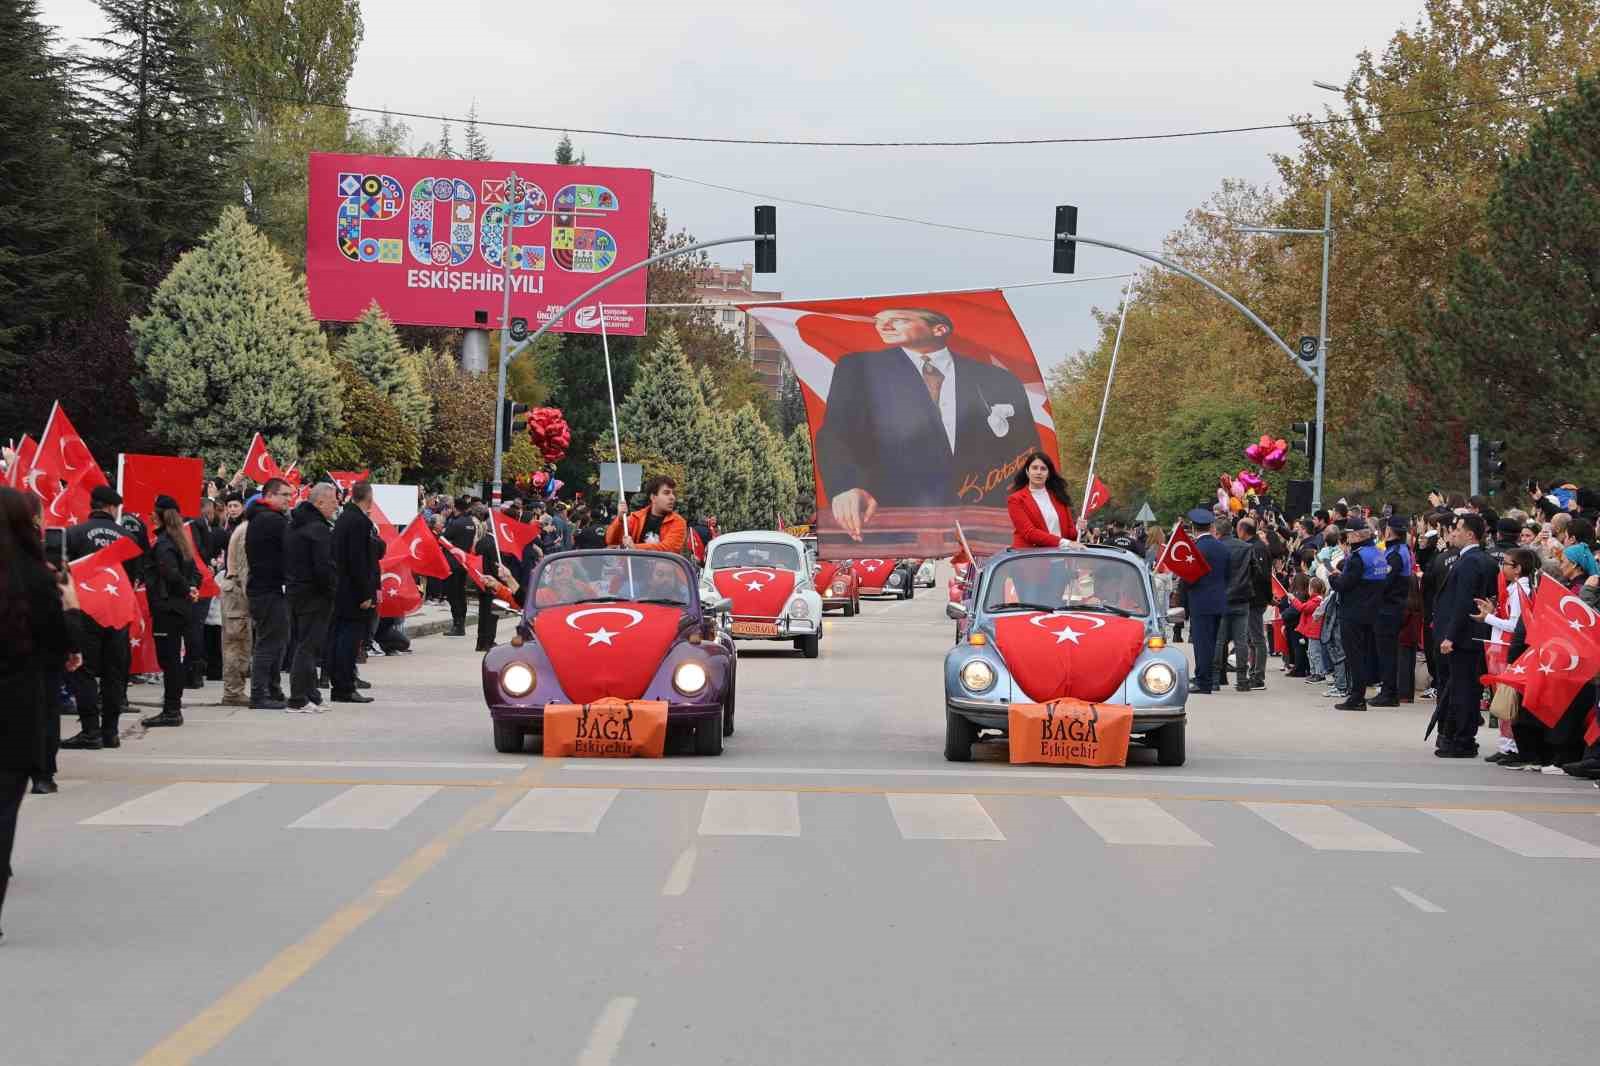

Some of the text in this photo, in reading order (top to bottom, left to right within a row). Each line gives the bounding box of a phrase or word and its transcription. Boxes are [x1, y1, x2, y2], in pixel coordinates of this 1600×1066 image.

[336, 172, 620, 274] 2026
[407, 266, 544, 294] ESKİŞEHİR YILI
